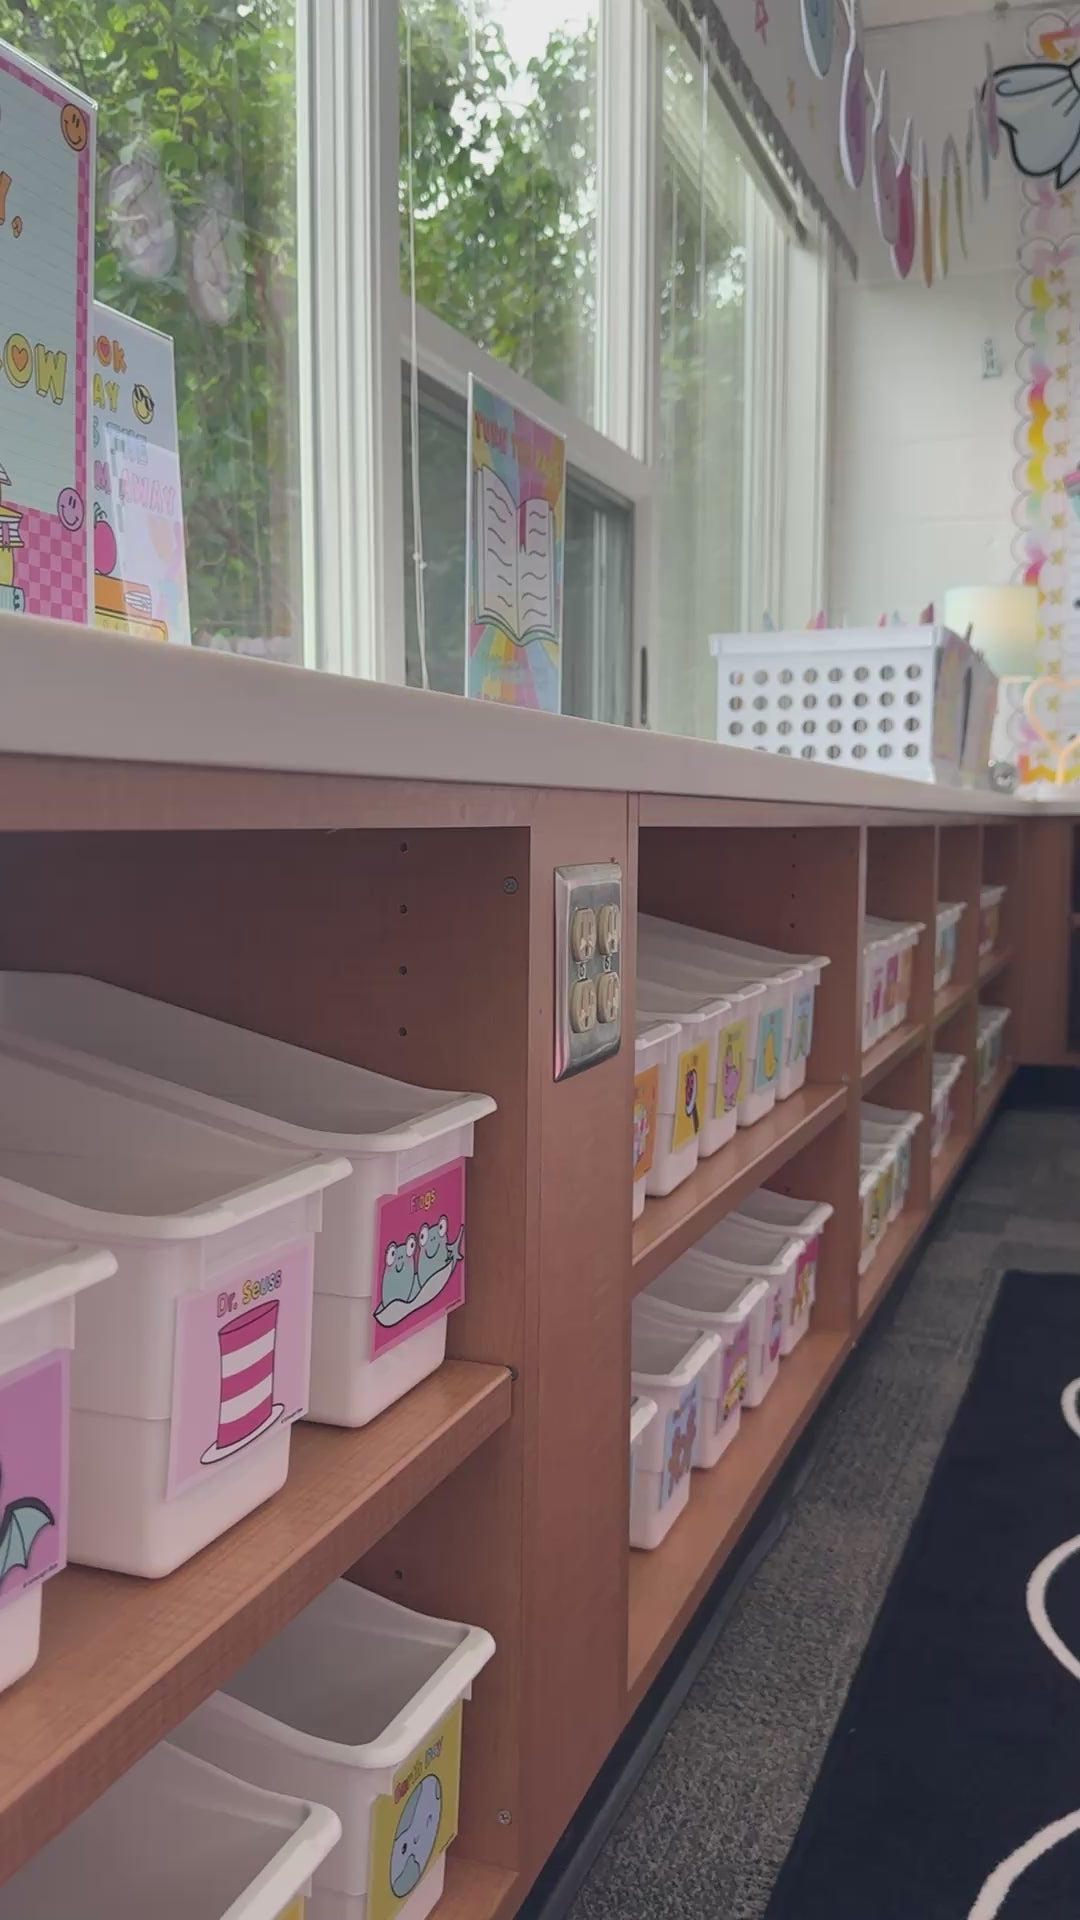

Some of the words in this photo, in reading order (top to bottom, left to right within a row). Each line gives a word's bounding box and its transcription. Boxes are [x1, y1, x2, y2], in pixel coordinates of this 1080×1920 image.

[0, 332, 67, 405] OW
[93, 334, 128, 374] OK
[216, 1292, 238, 1318] Dr.
[242, 1269, 282, 1305] Seuss
